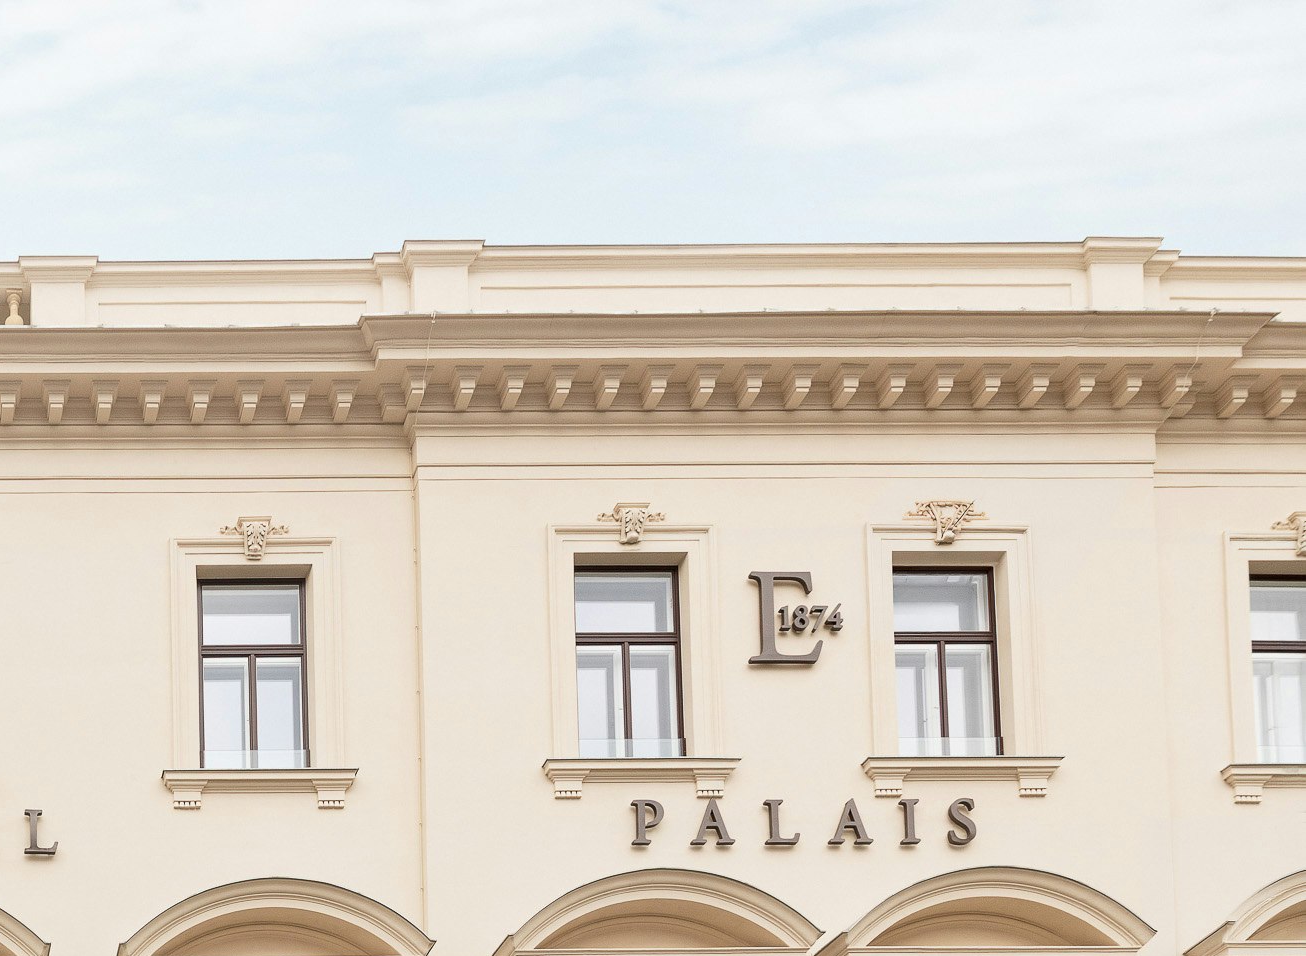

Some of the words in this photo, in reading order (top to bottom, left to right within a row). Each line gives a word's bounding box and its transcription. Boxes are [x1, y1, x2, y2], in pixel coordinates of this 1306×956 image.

[748, 571, 824, 665] E
[777, 602, 844, 634] 1874
[630, 797, 977, 846] PALAIS
